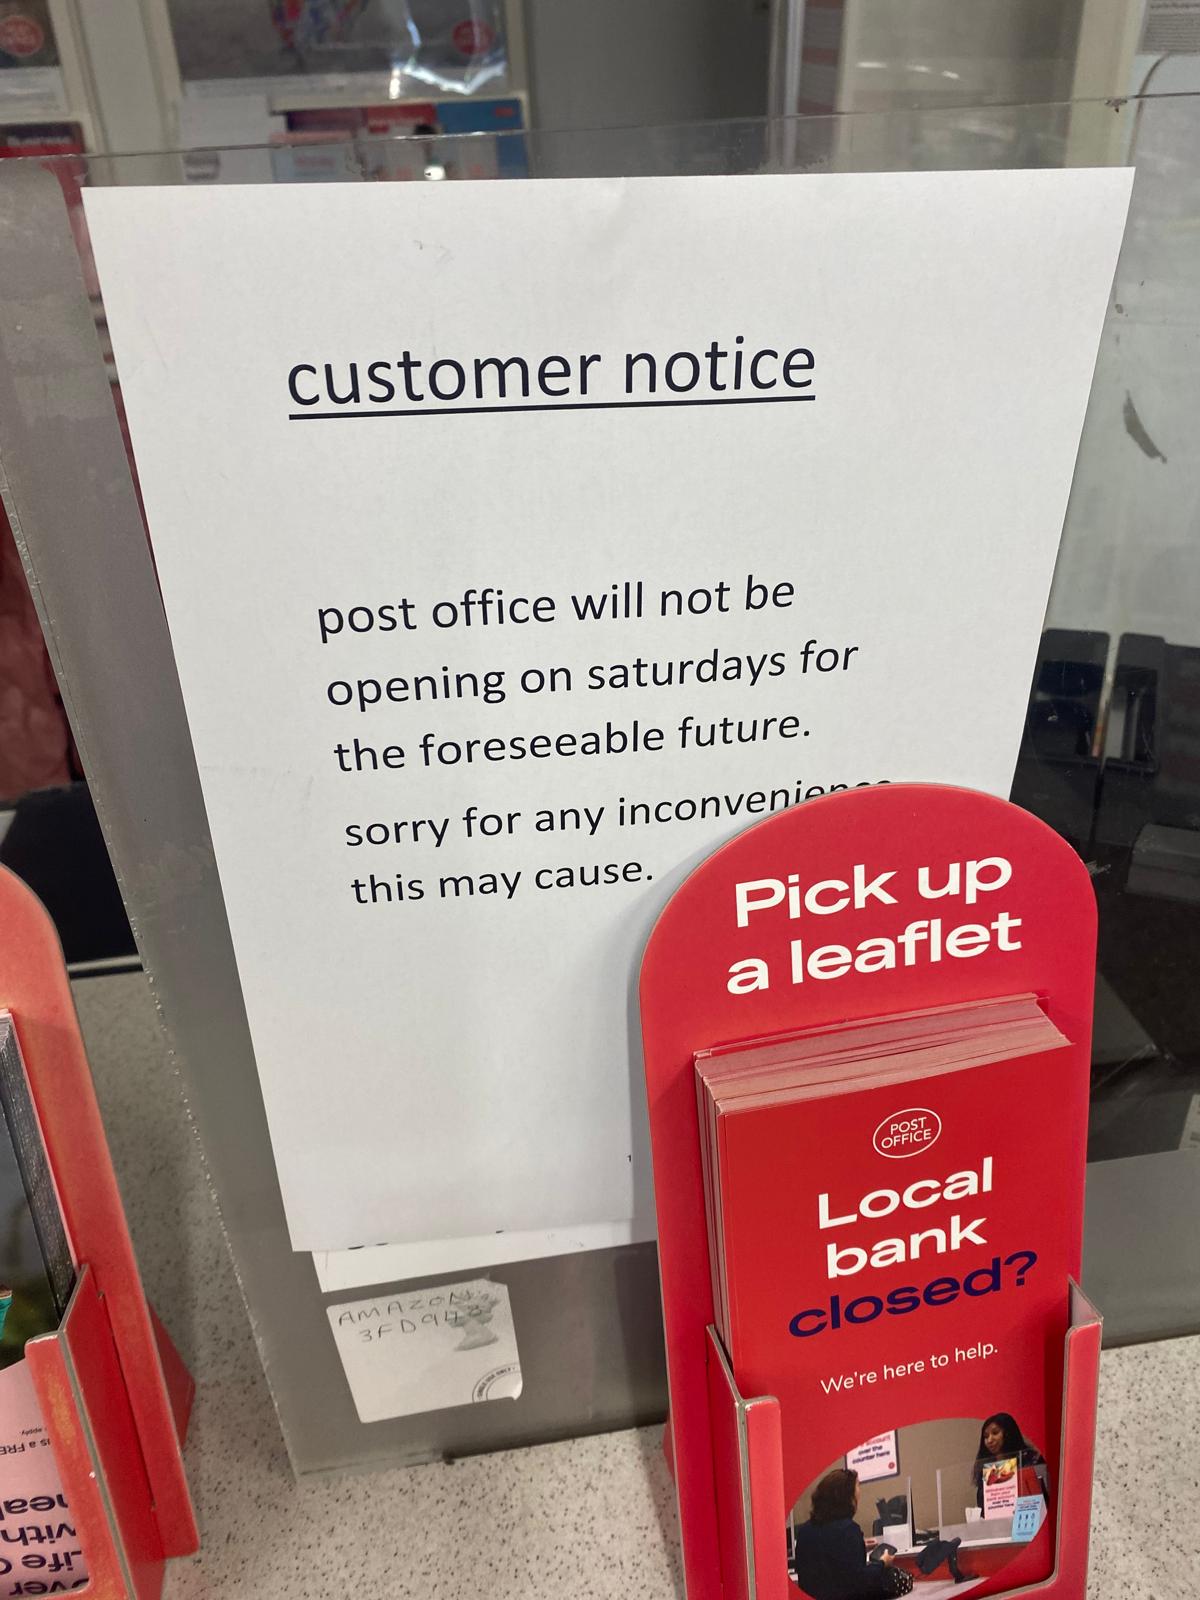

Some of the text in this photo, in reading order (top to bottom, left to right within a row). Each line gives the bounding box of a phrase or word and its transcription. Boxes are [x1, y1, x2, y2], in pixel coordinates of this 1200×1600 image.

[288, 335, 815, 406] customer notice
[318, 574, 795, 644] post office will not be
[327, 639, 859, 713] opening on saturdays for
[333, 713, 812, 772] the foreseeable future.
[345, 779, 893, 848] sorry for any inconvenie
[350, 861, 654, 905] this may cause.
[736, 857, 1012, 927] Pick up
[727, 912, 1022, 994] a leaflet
[880, 1128, 932, 1148] OFFICE
[889, 1116, 927, 1136] POST
[818, 1157, 993, 1230] Local
[826, 1216, 988, 1279] bank
[338, 1289, 472, 1326] AMAZON
[789, 1250, 1038, 1337] closed?
[820, 1342, 998, 1395] We're here to help.
[29, 1441, 36, 1449] a
